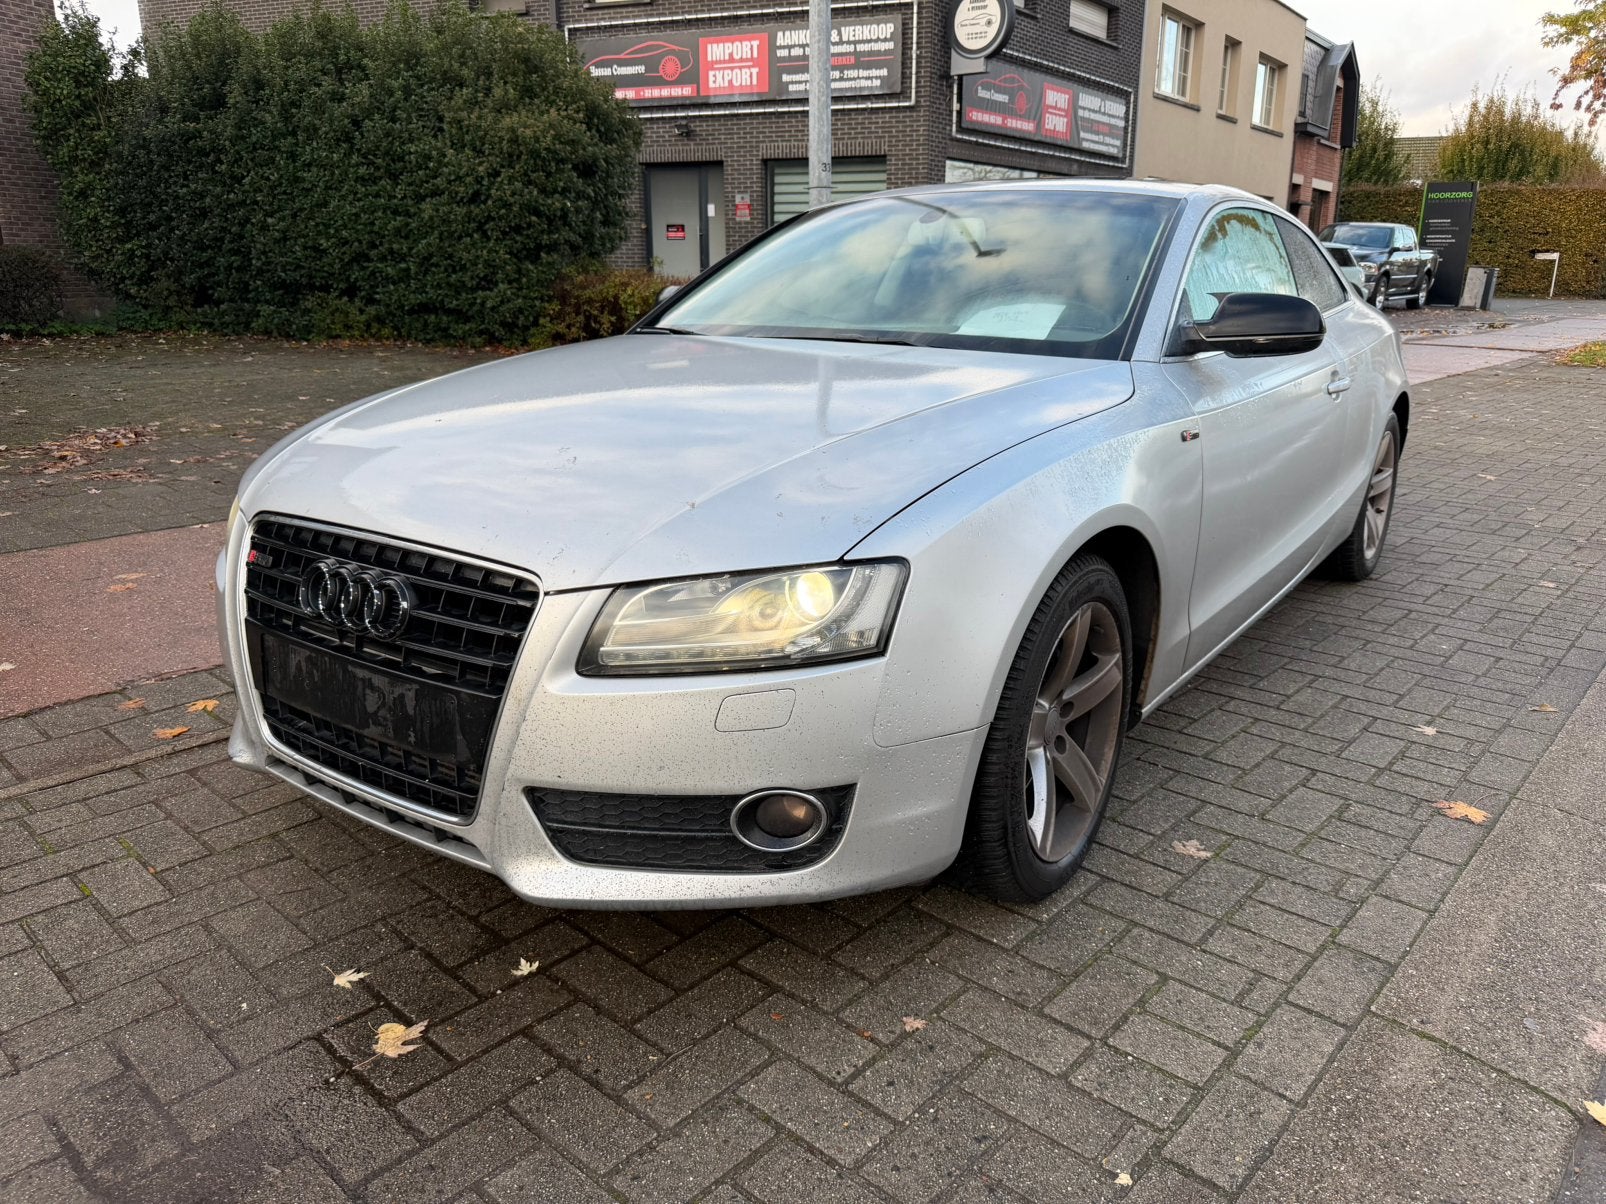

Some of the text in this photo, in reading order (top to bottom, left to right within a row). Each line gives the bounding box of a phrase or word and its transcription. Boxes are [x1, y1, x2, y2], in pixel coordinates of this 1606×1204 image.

[831, 29, 840, 43] &
[841, 23, 895, 41] VERKOOP
[707, 40, 760, 62] IMPORT
[776, 49, 789, 57] van
[790, 47, 804, 56] alle
[856, 41, 895, 52] voertuigen
[612, 64, 646, 76] Commerce
[708, 67, 760, 88] EXPORT
[1046, 89, 1069, 110] IMPORT
[1045, 113, 1067, 133] EXPORT
[1428, 191, 1473, 199] HOORZORG
